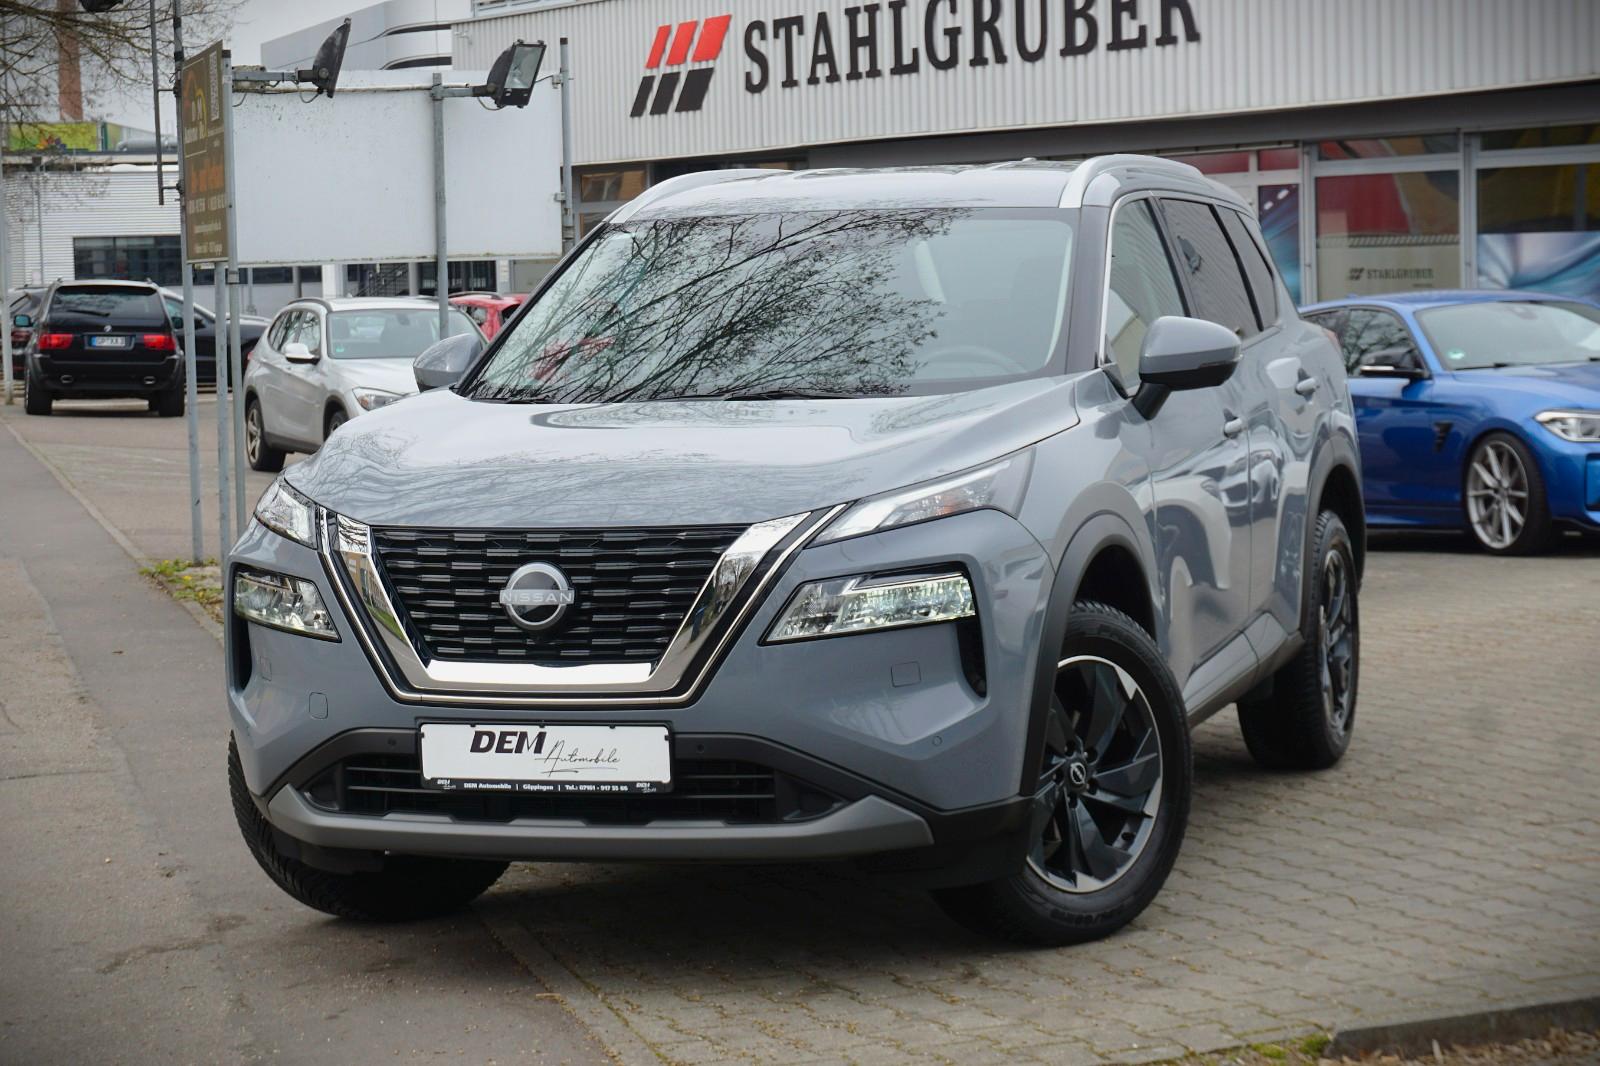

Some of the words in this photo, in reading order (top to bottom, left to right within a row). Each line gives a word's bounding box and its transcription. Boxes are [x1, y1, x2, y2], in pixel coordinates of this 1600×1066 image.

[501, 592, 572, 602] NISSAN
[470, 730, 547, 754] DEM
[534, 739, 621, 777] Automobile
